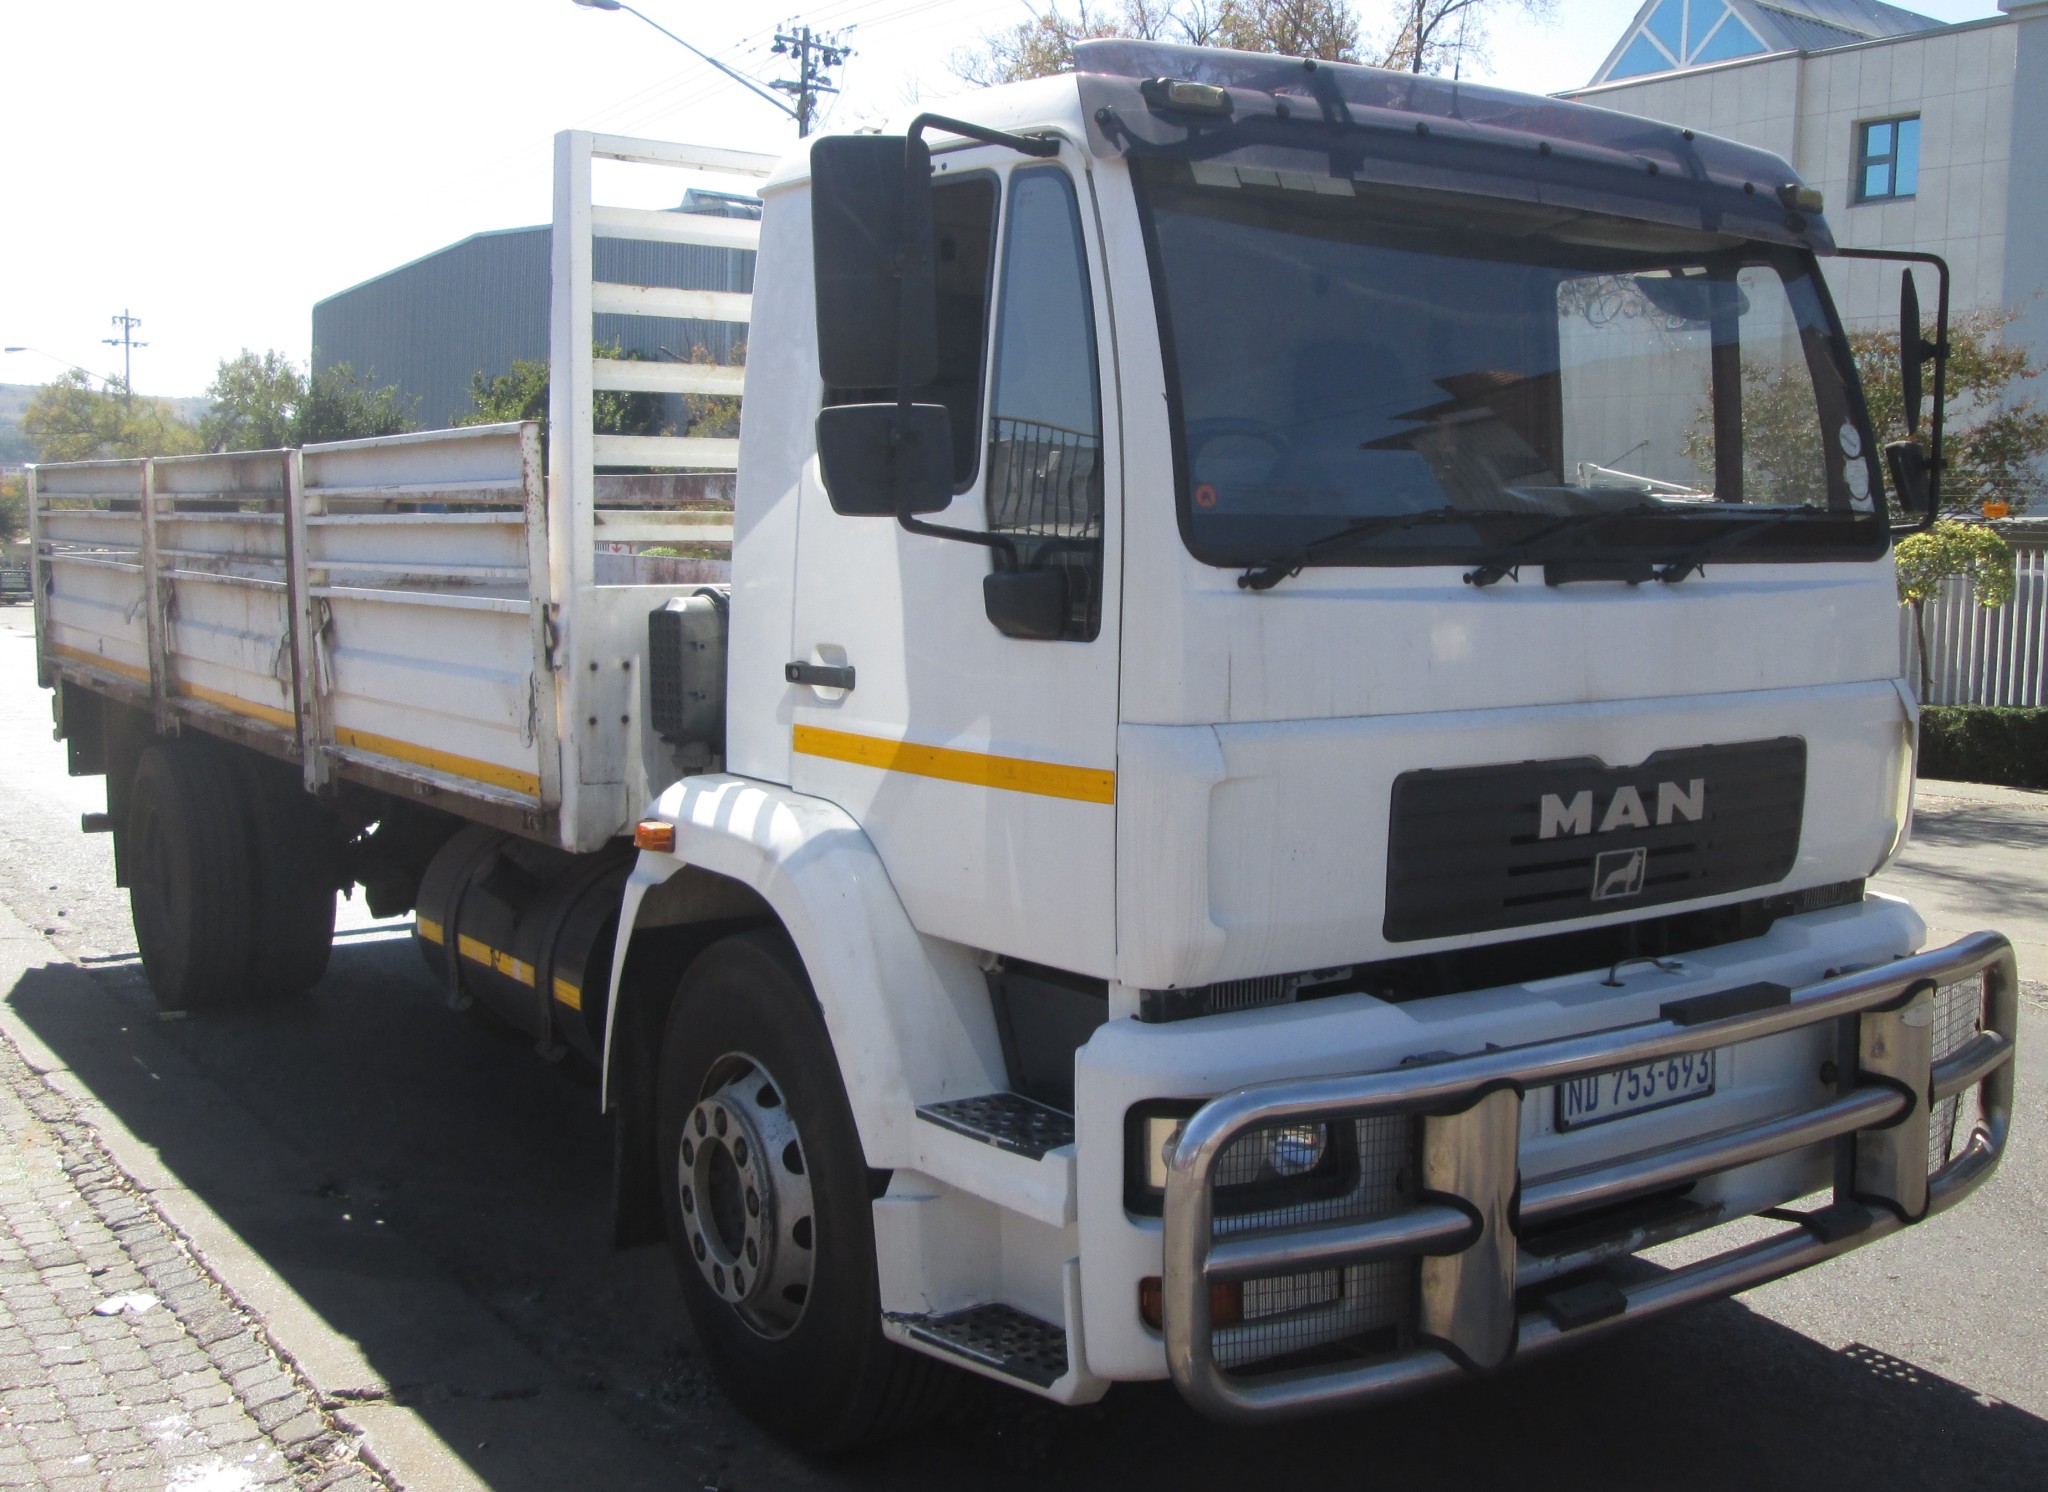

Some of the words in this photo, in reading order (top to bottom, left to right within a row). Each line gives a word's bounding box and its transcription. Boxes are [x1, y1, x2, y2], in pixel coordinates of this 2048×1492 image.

[1539, 778, 1704, 839] MAN
[1568, 1076, 1599, 1116] ND
[1611, 1051, 1709, 1105] 753-693
